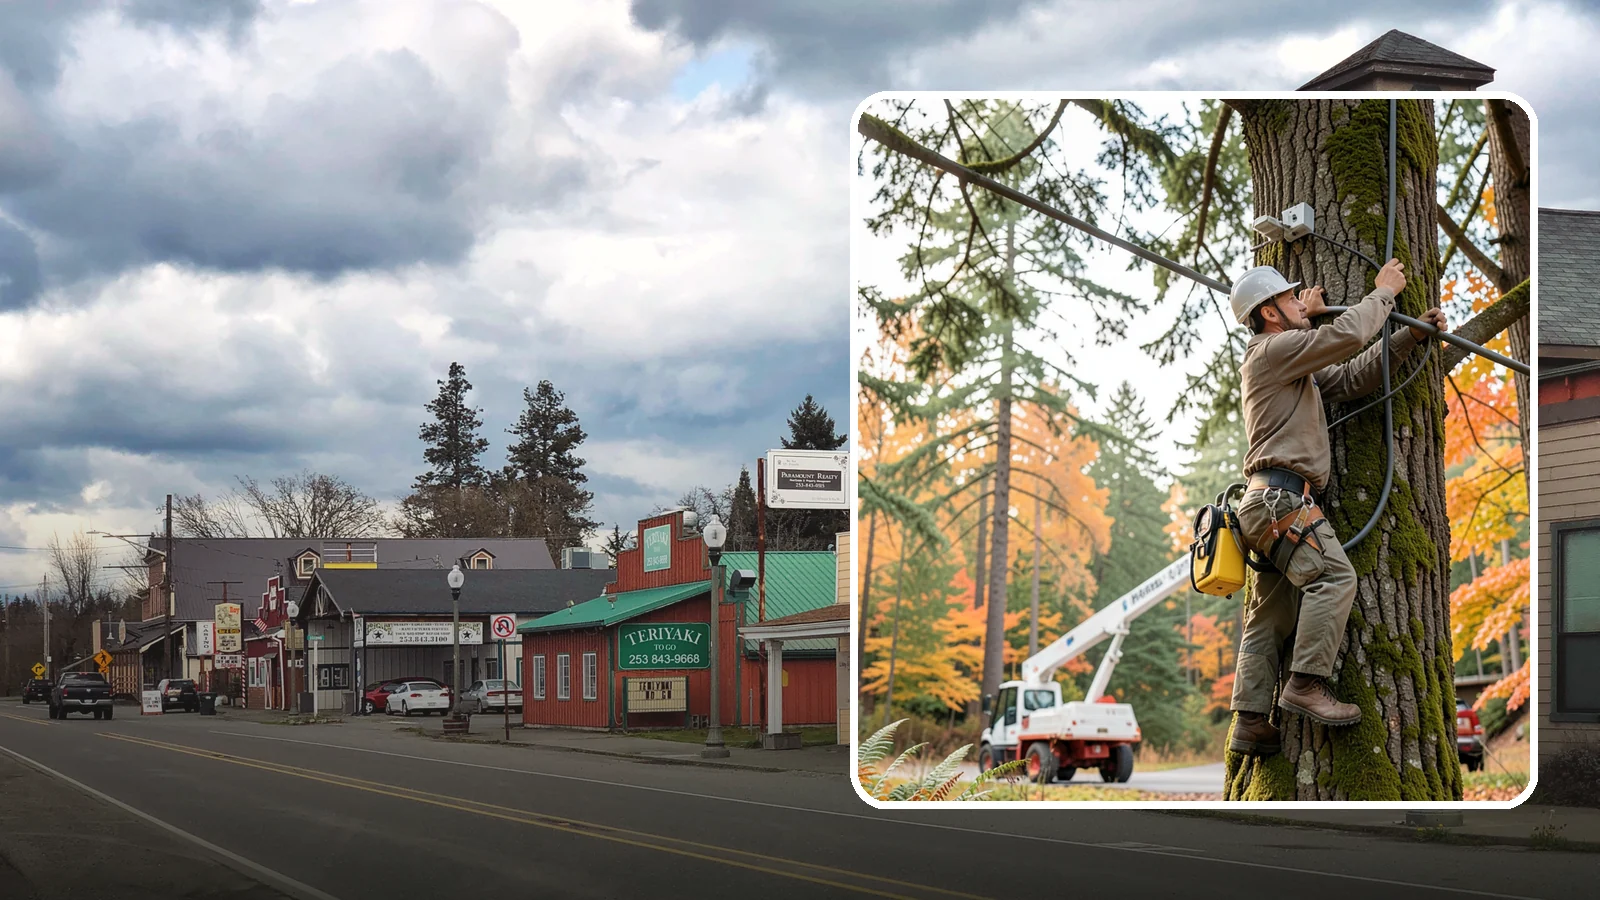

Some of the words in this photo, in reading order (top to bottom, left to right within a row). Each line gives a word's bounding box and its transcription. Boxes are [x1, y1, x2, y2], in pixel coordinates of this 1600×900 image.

[624, 627, 702, 646] TERIYAKI
[628, 654, 649, 665] 253
[651, 653, 700, 664] 843-9668
